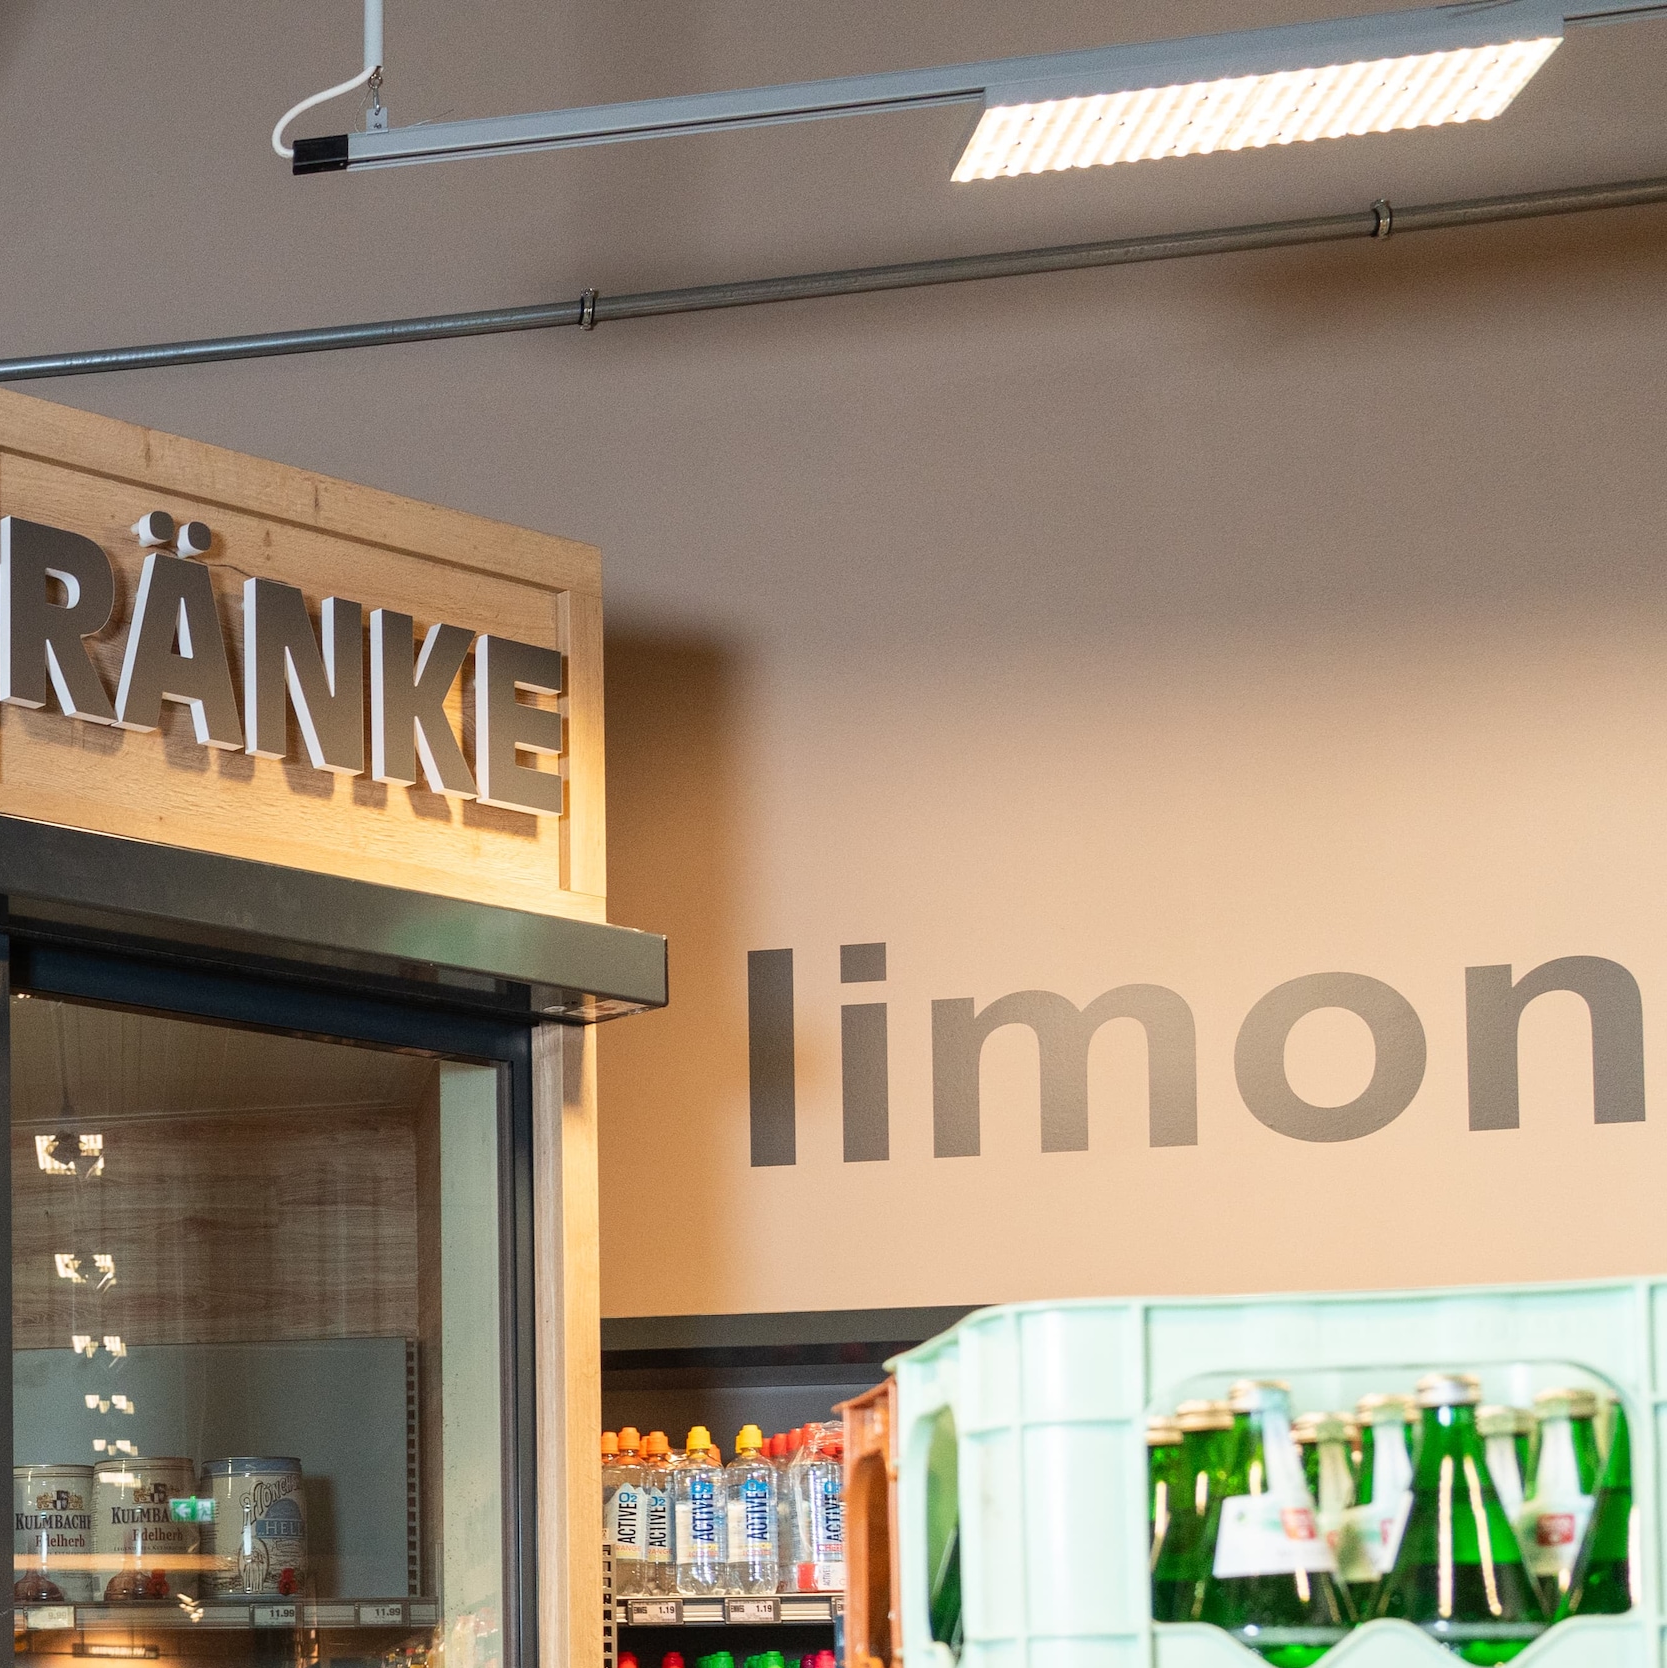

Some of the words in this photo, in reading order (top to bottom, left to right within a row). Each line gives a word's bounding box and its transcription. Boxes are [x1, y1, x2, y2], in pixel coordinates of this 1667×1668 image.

[747, 942, 1646, 1167] limon
[618, 1492, 638, 1503] O2
[617, 1502, 637, 1545] ACTIVE
[649, 1506, 666, 1548] ACTIVE
[697, 1493, 714, 1541] ACTIVE
[747, 1490, 768, 1540] ACTIVE
[269, 1609, 295, 1618] 11.99
[375, 1607, 401, 1616] 11.99
[657, 1606, 675, 1615] 1.19
[754, 1605, 772, 1614] 1.19
